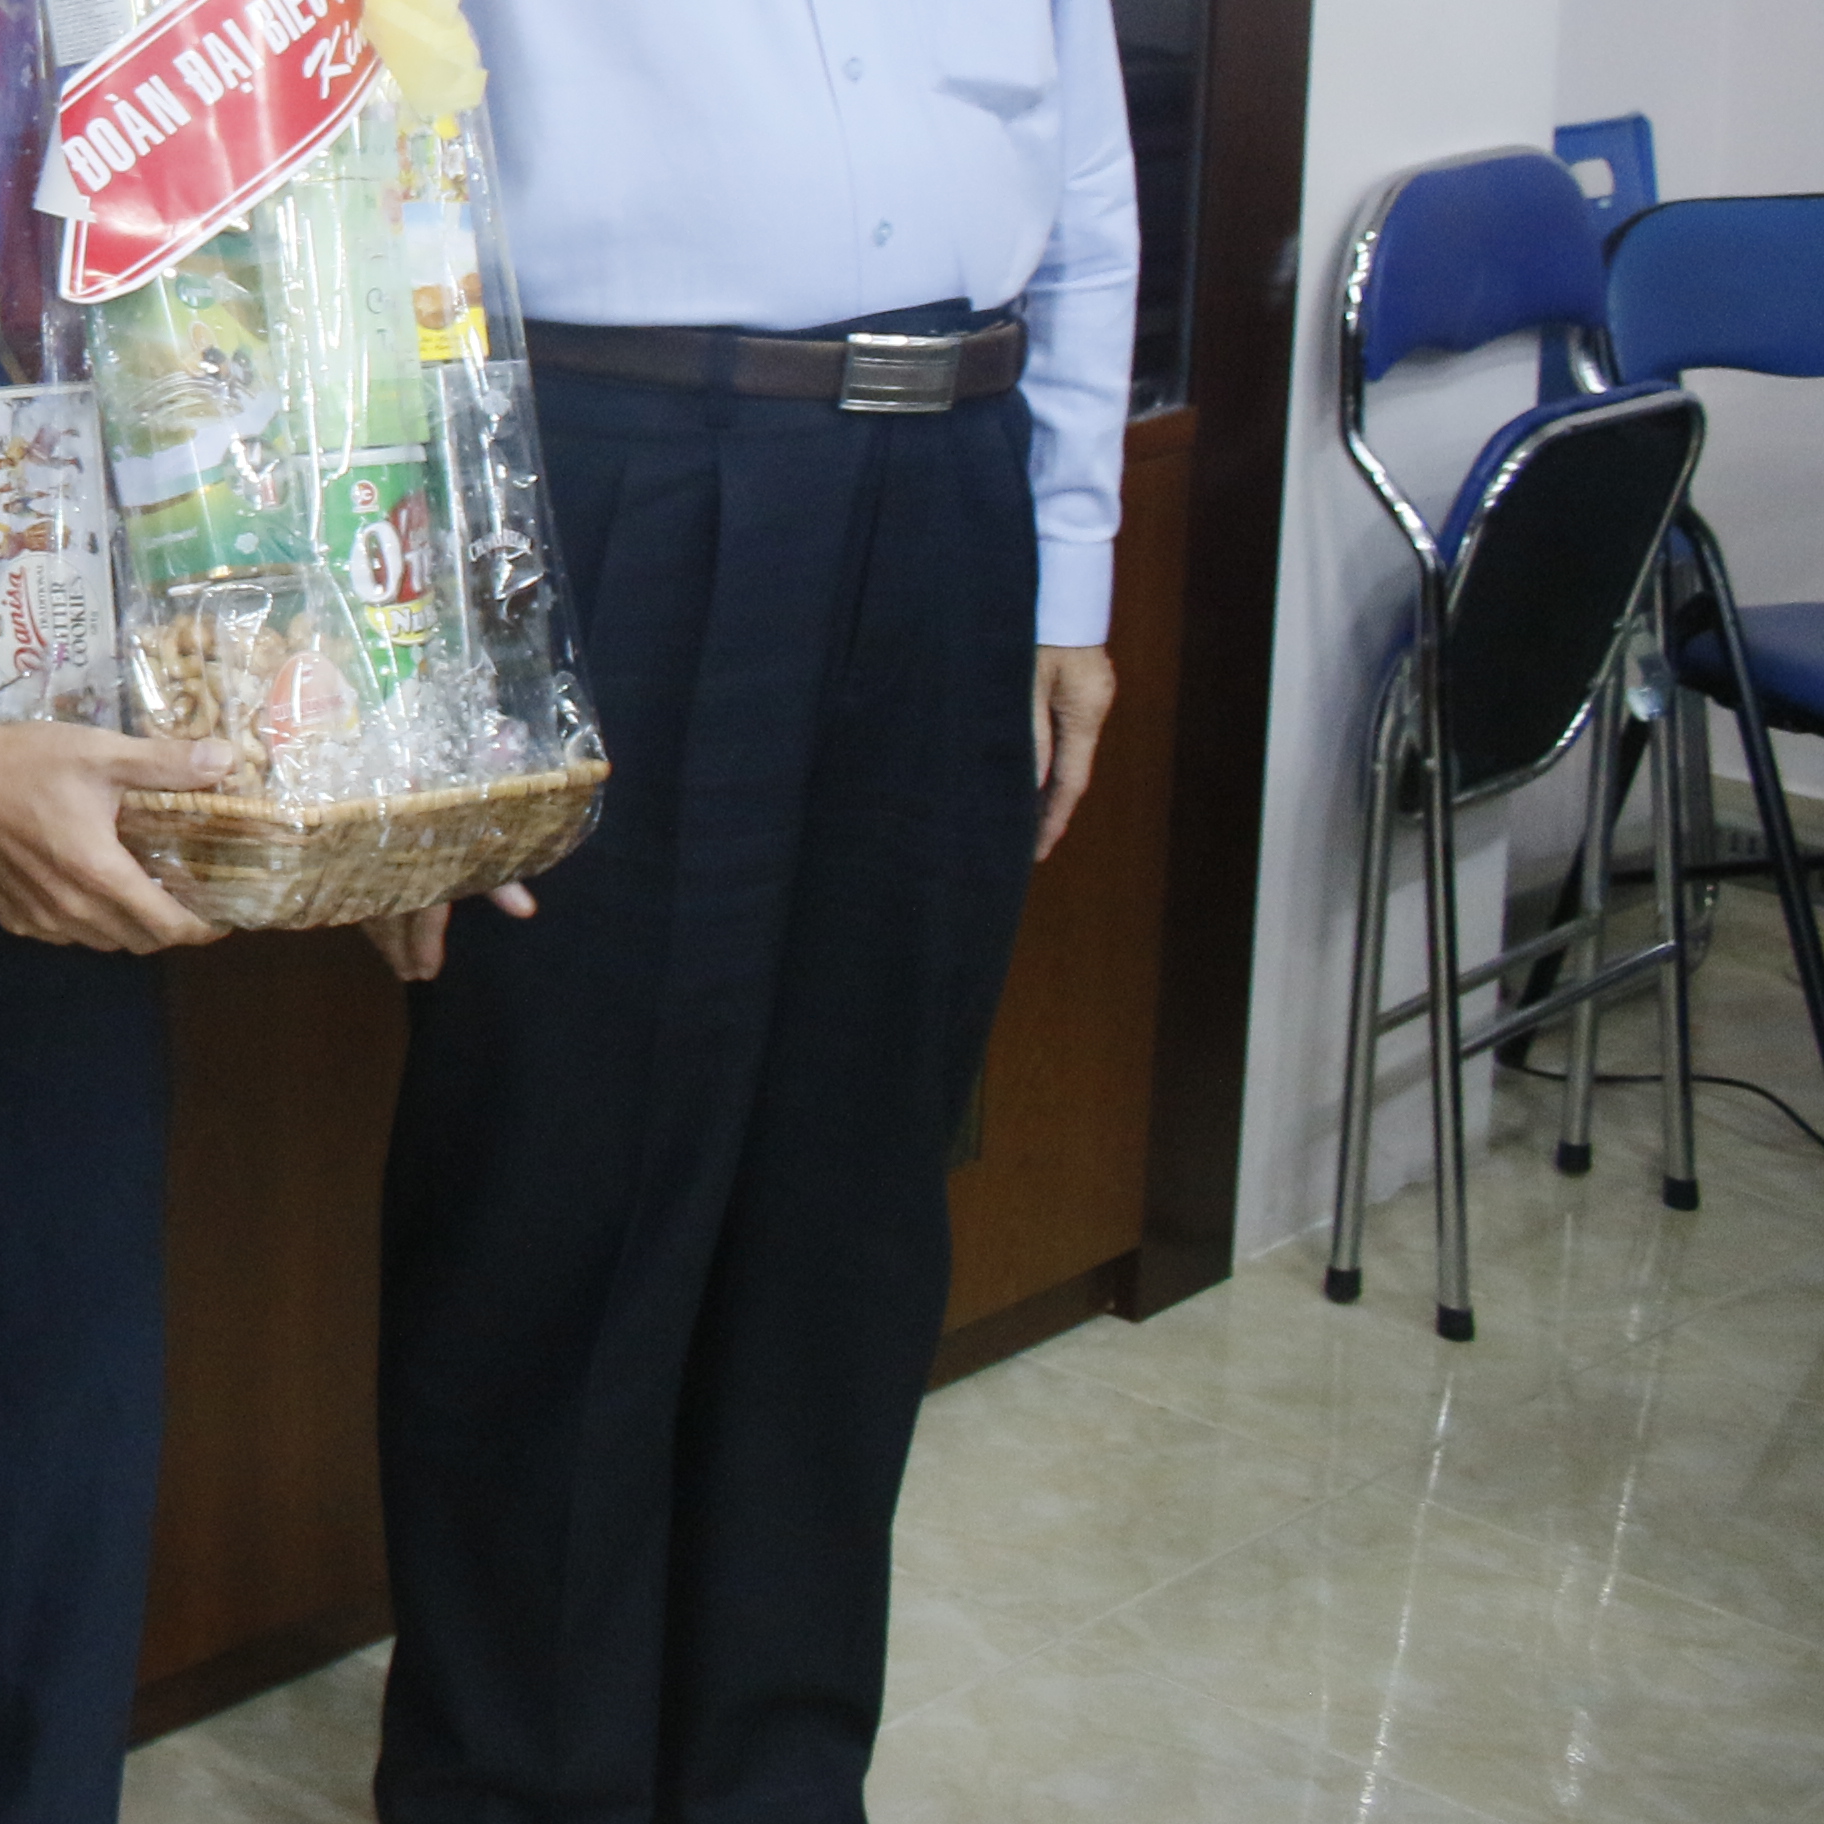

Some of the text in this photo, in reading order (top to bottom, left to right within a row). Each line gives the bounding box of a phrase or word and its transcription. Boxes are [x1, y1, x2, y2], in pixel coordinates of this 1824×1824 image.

[61, 74, 192, 193] ĐOÀN
[172, 18, 265, 107] ĐẠI
[2, 565, 46, 673] Danisa
